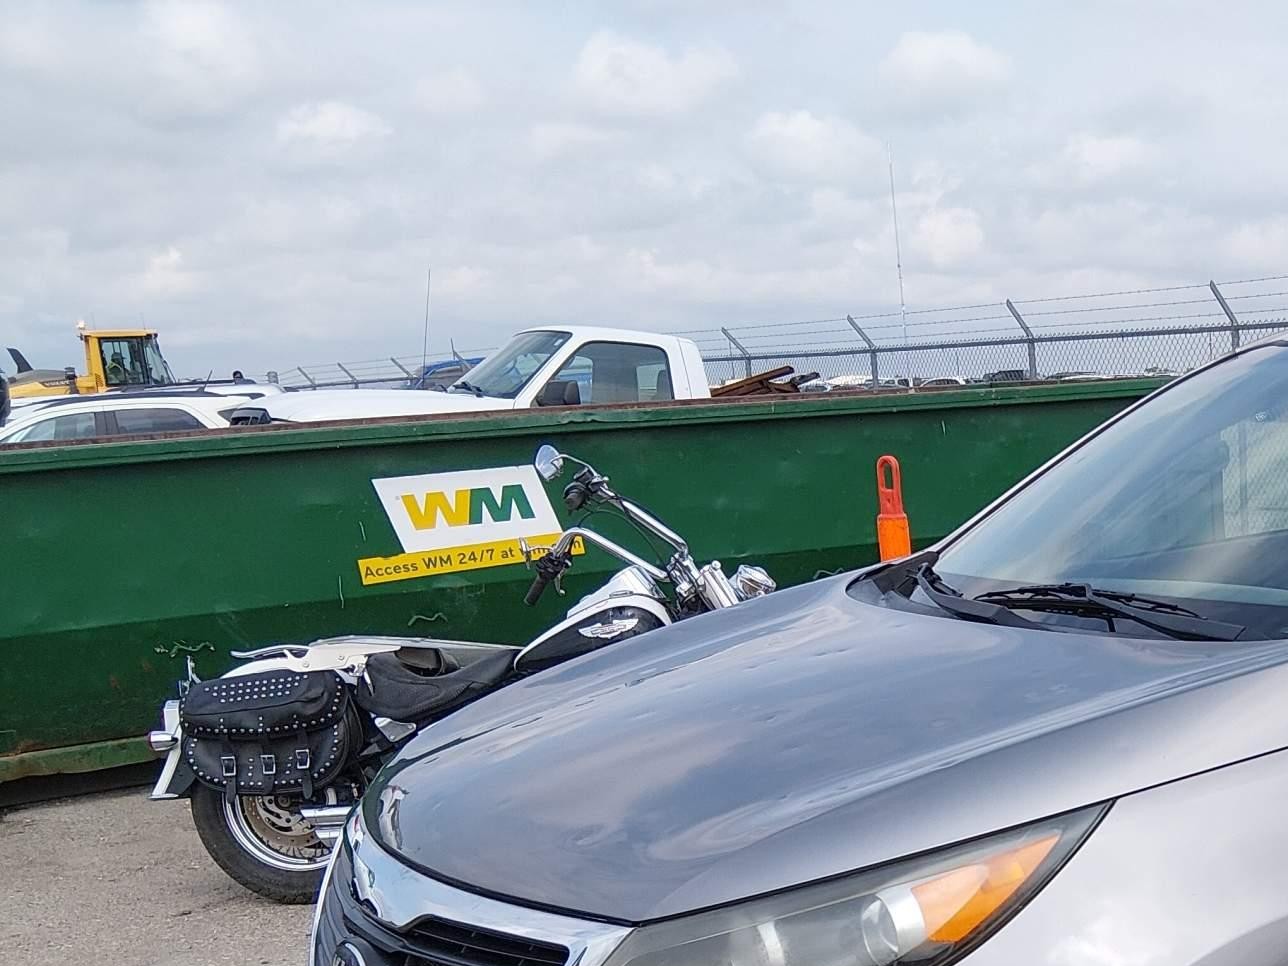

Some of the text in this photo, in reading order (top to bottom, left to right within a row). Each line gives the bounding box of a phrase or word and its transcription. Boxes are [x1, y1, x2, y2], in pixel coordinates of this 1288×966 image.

[401, 484, 536, 531] WM
[364, 561, 418, 579] Access
[422, 553, 453, 570] WM
[457, 547, 495, 565] 24/7
[501, 546, 515, 560] at
